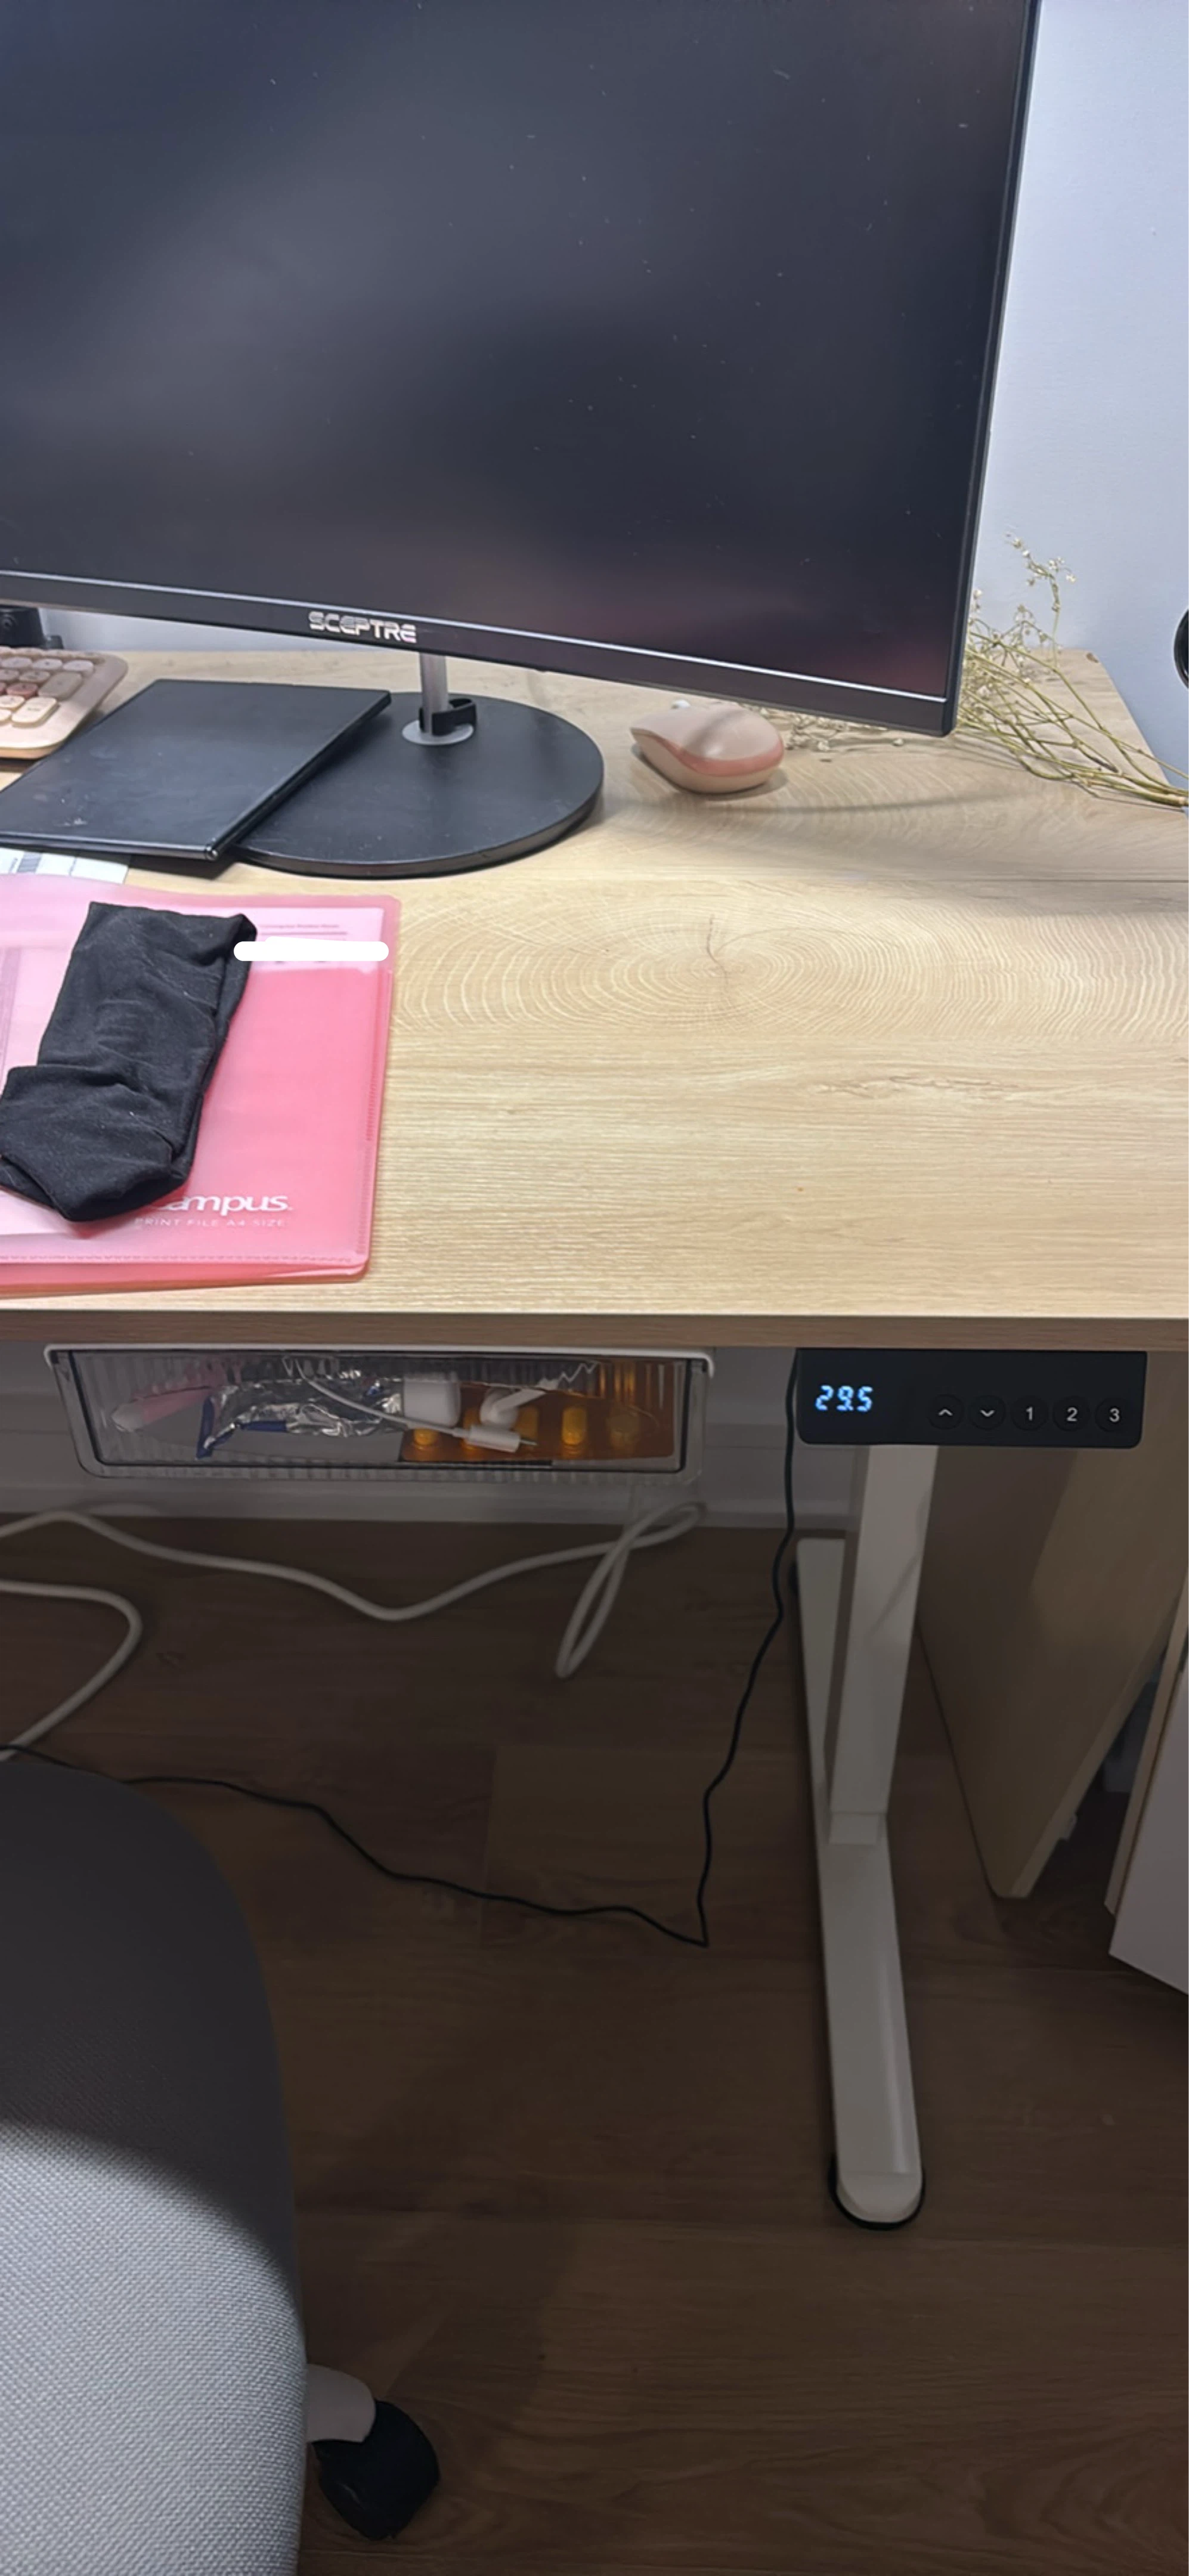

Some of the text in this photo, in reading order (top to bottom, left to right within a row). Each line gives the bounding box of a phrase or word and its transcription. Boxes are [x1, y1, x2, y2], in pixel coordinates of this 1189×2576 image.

[308, 611, 416, 643] SCEPTRE
[157, 1195, 289, 1216] ampus
[185, 1219, 219, 1227] FILE
[226, 1219, 246, 1227] A4
[253, 1219, 285, 1227] SIZE
[815, 1385, 873, 1412] 29.5
[1026, 1406, 1120, 1423] 1 2 3
